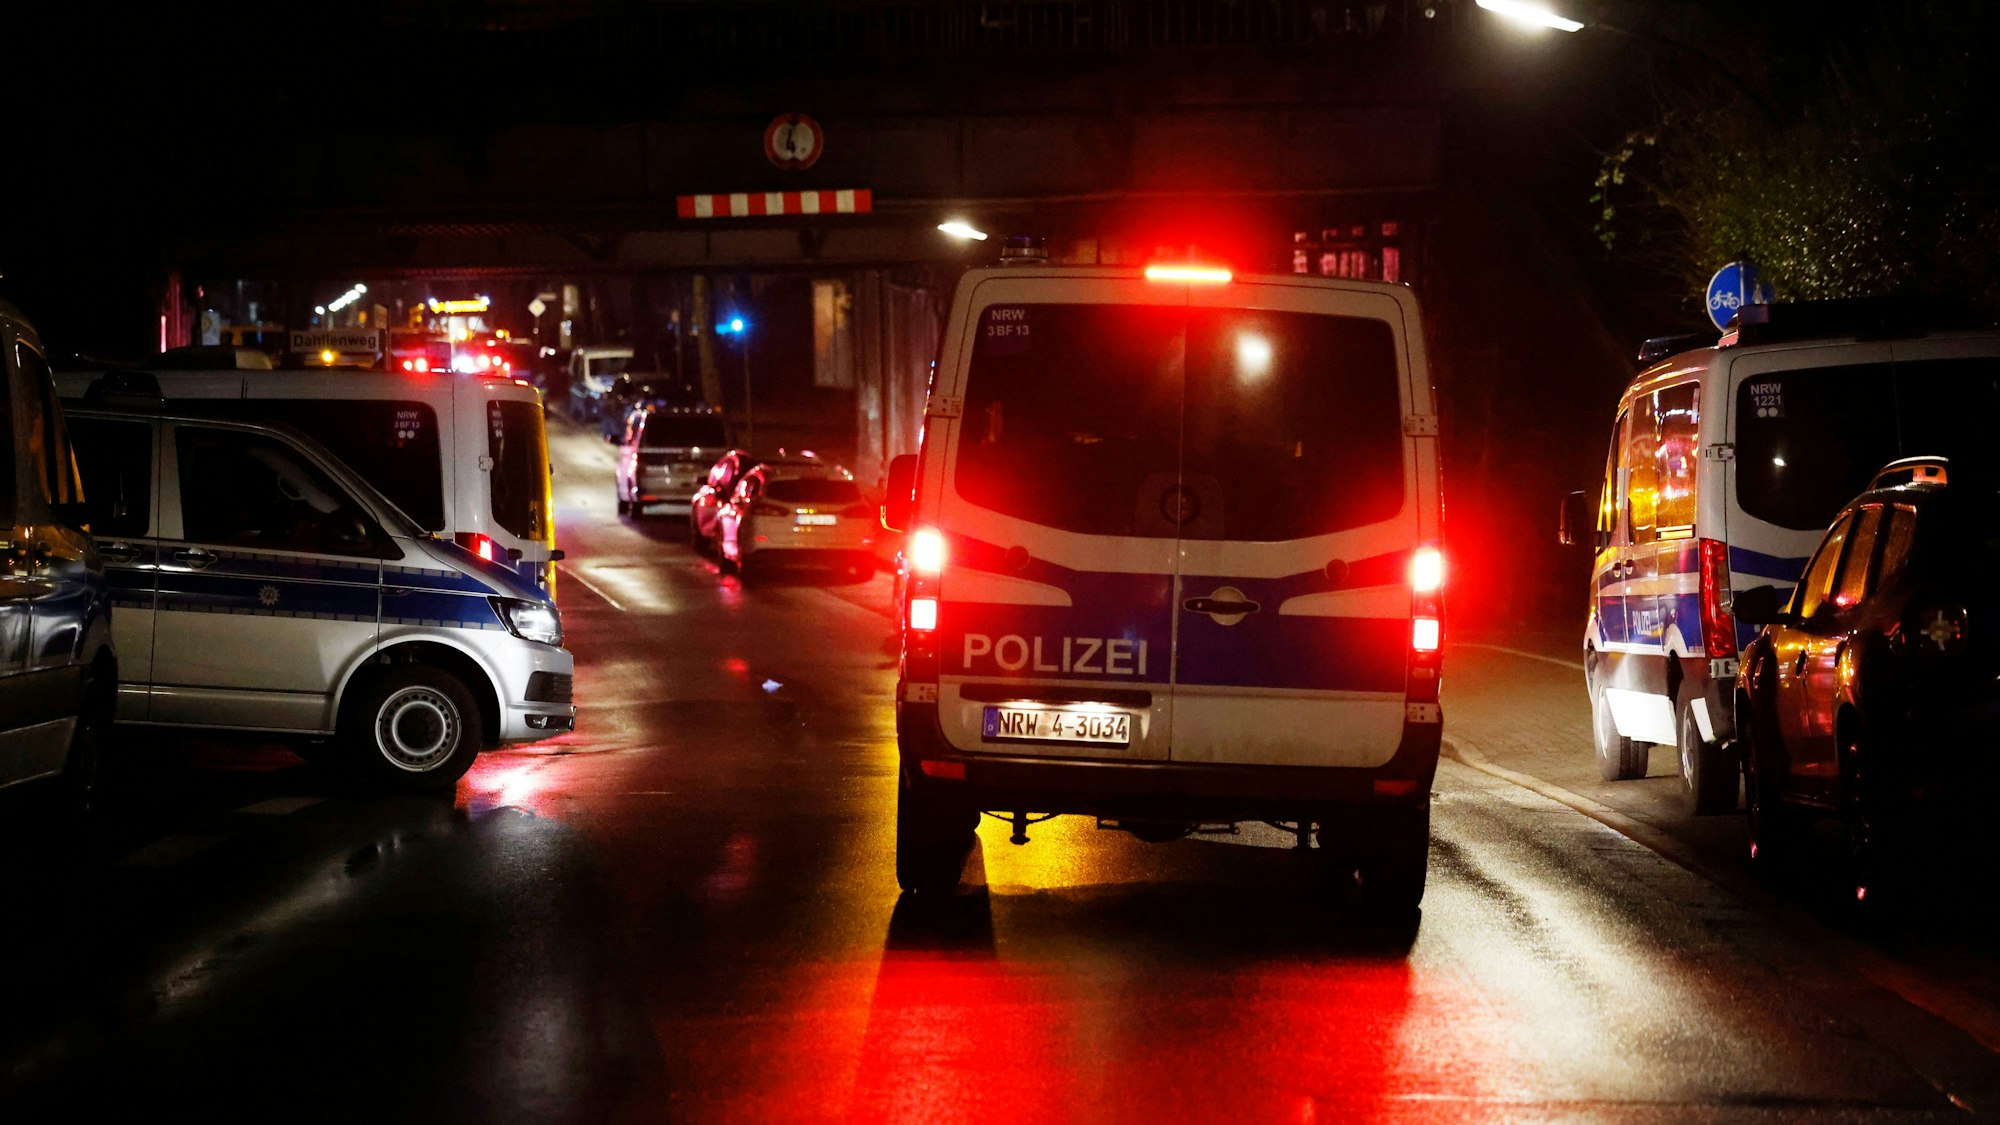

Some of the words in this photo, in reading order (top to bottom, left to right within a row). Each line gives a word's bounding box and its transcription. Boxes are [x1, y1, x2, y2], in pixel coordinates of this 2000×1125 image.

[992, 309, 1025, 320] NRW
[988, 326, 995, 336] 3
[996, 325, 1013, 336] BF
[1016, 325, 1029, 336] 13
[293, 334, 376, 349] Dahlienweg
[1750, 383, 1782, 395] NRW
[1753, 395, 1781, 406] 1221
[397, 411, 418, 419] NRW
[963, 633, 1148, 676] POLIZEI
[999, 711, 1039, 736] NRW
[1052, 714, 1128, 741] 4-3034
